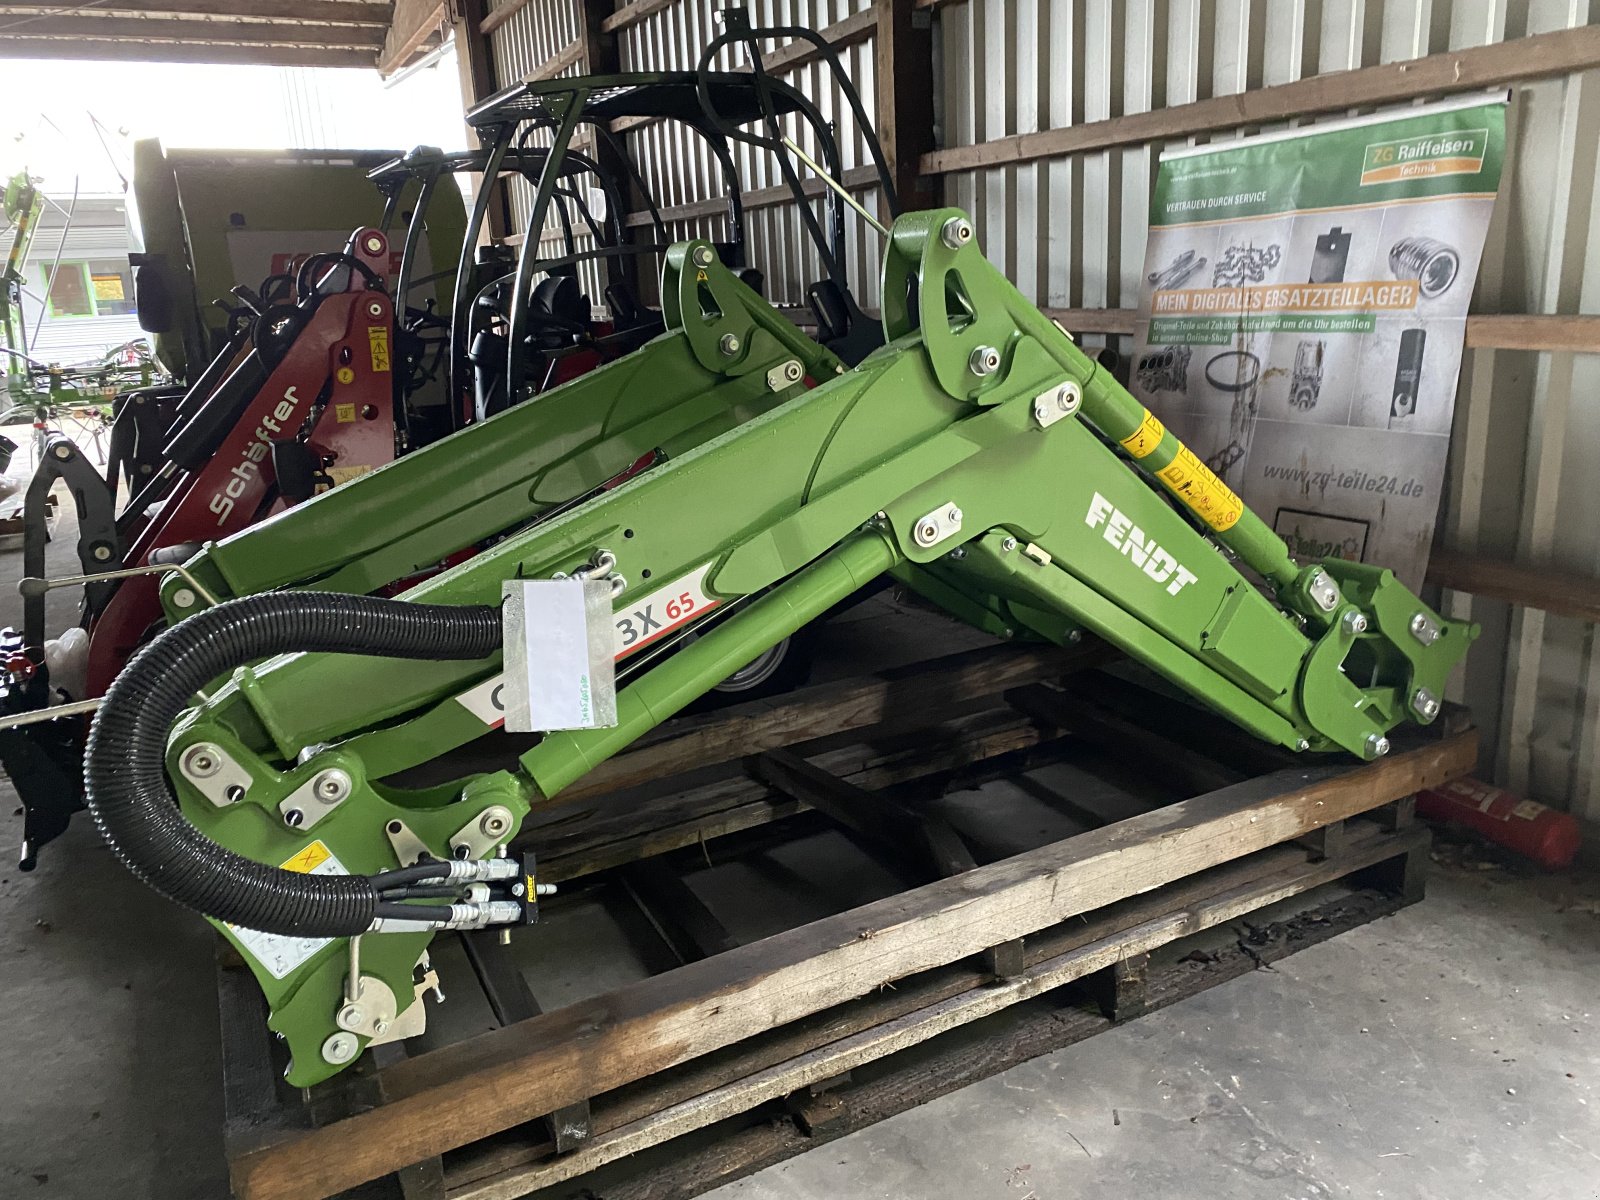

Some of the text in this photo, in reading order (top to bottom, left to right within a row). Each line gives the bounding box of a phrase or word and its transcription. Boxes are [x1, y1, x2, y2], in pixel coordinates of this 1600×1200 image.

[1373, 138, 1474, 163] ZG Raiffeisen
[1400, 162, 1437, 176] Technik
[1166, 190, 1267, 213] VERTRAUEN DURCH SERVICE
[1156, 285, 1414, 311] MEIN DIGITALES ERSATZTEILLAGER
[1153, 319, 1196, 333] Original-Teile
[1196, 319, 1210, 330] und
[1210, 319, 1239, 331] Zubehör
[1282, 320, 1297, 329] um
[1299, 318, 1312, 329] die
[1313, 318, 1330, 329] Uhr
[1330, 318, 1371, 329] bestellen
[1186, 332, 1228, 344] Online-Shop
[209, 385, 299, 526] Schäffer
[1263, 464, 1424, 498] www.zg-teile24.de
[1085, 491, 1199, 596] FENDT
[616, 592, 695, 646] 3X 65
